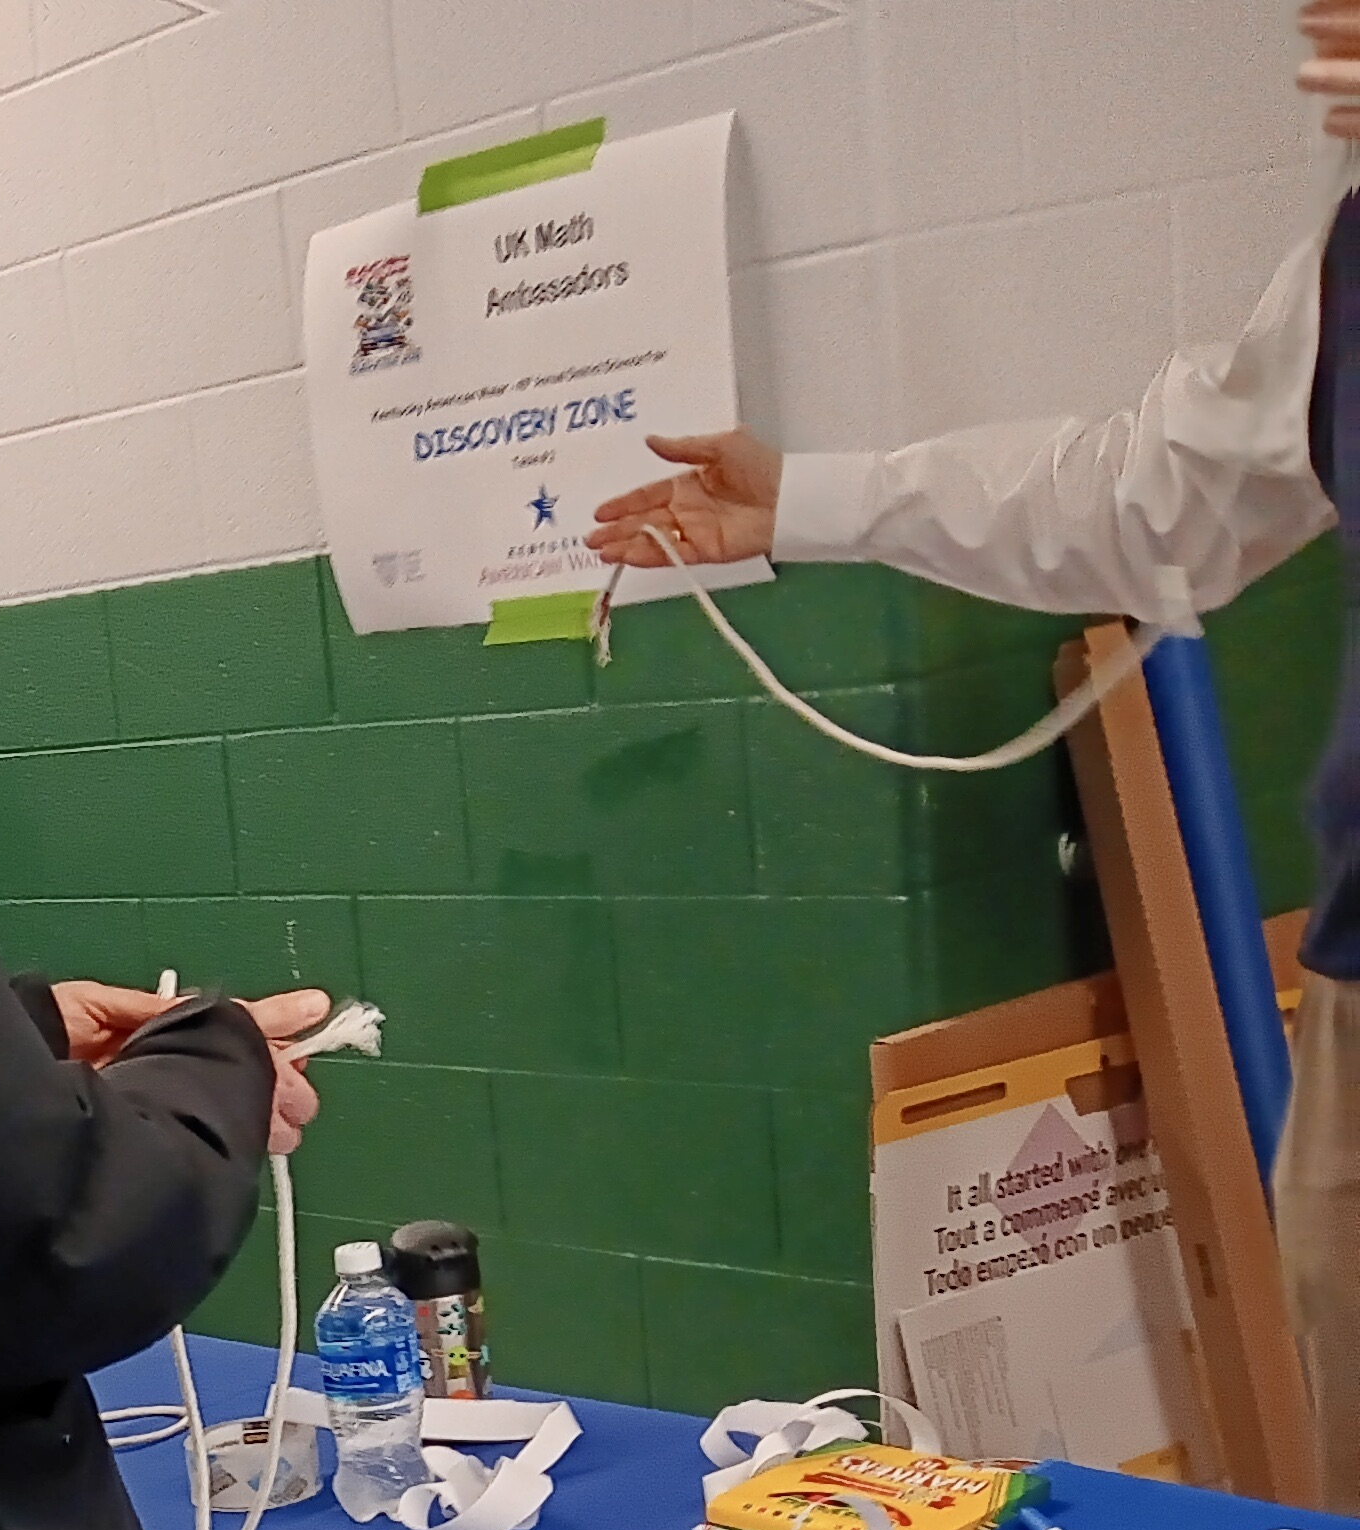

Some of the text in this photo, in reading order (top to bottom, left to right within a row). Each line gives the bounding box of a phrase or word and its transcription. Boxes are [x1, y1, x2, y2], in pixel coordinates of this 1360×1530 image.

[494, 211, 594, 263] UK Math
[414, 404, 557, 462] DISCOVERY
[563, 387, 637, 433] ZONE
[947, 1185, 963, 1213] It
[967, 1170, 991, 1206] all
[996, 1151, 1063, 1198] started
[1067, 1140, 1109, 1178] with
[933, 1220, 979, 1254] Tout
[983, 1220, 996, 1241] a
[1001, 1179, 1101, 1236] commencé
[1106, 1176, 1146, 1206] avec
[924, 1258, 972, 1296] Todo
[977, 1232, 1051, 1283] empezó
[1055, 1233, 1088, 1259] con
[1092, 1223, 1118, 1249] un
[836, 1455, 989, 1495] MARKERS
